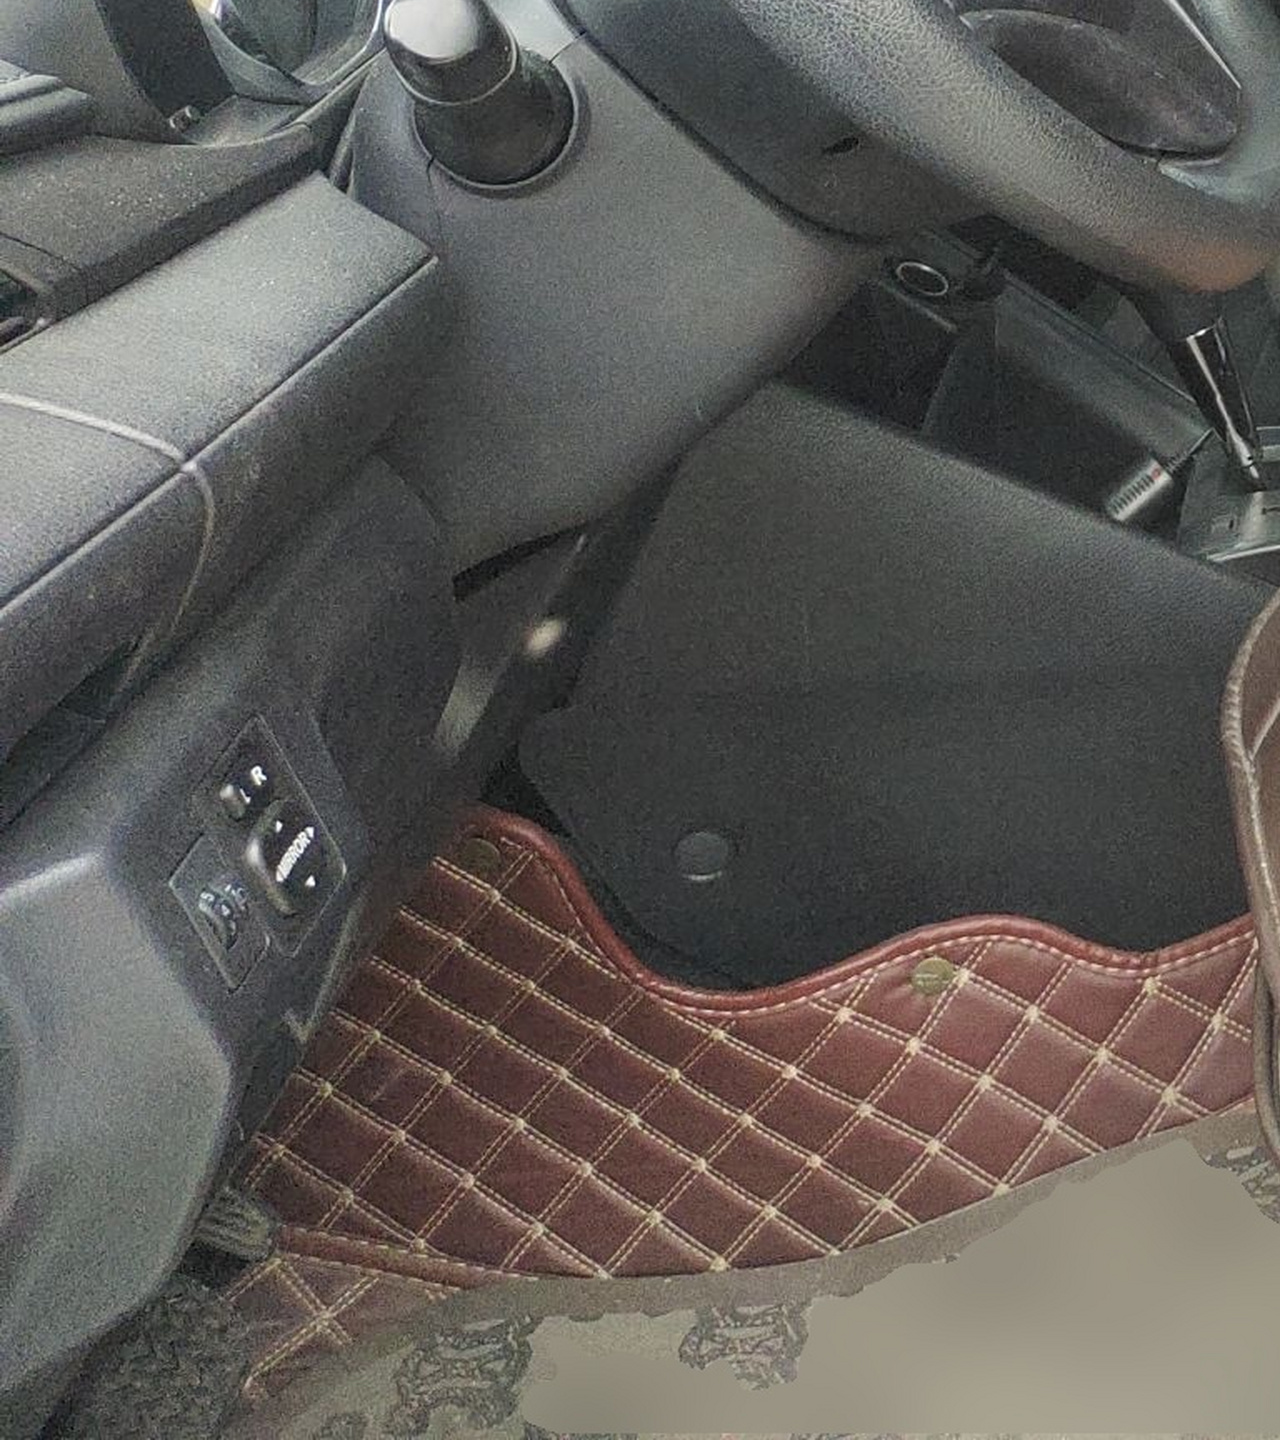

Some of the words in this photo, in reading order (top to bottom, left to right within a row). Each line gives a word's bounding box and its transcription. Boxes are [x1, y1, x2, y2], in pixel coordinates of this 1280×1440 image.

[250, 765, 267, 786] R
[239, 788, 251, 804] L
[278, 831, 310, 879] MIRROR
